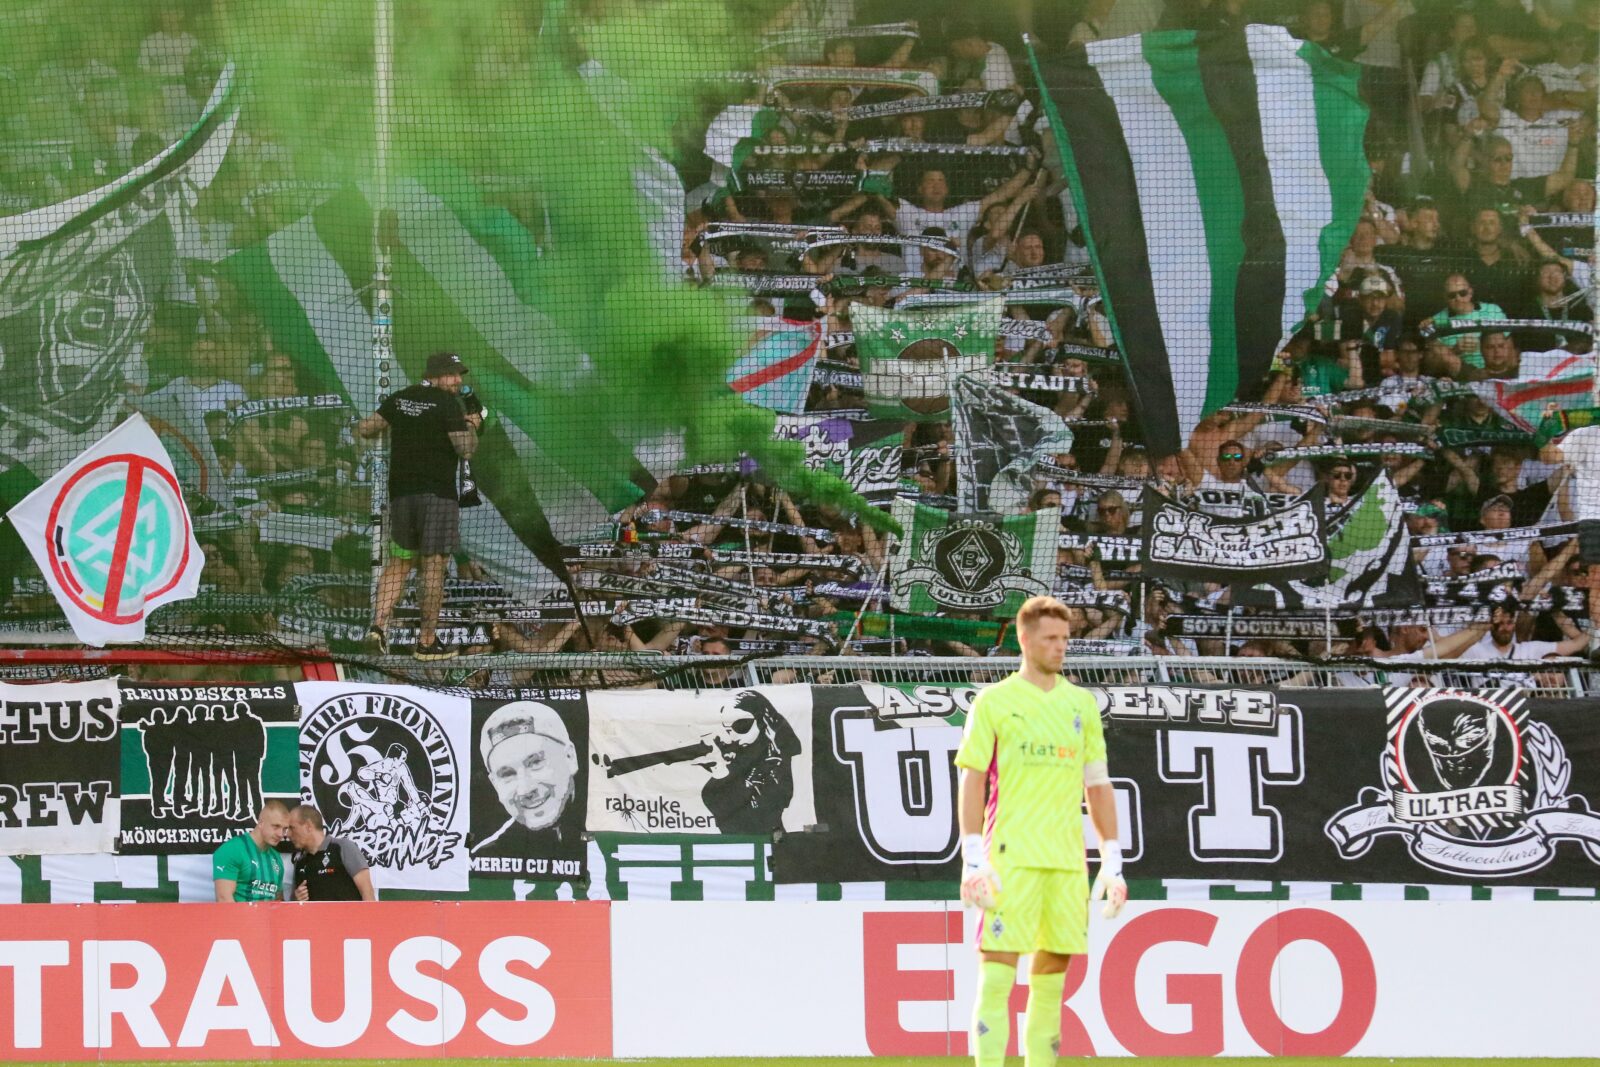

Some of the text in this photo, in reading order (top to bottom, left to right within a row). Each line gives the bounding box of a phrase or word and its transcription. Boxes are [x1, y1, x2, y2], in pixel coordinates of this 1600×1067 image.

[605, 793, 681, 816] rabauke
[1408, 789, 1508, 818] ULTRAS
[468, 856, 581, 877] MEREU CU NOI
